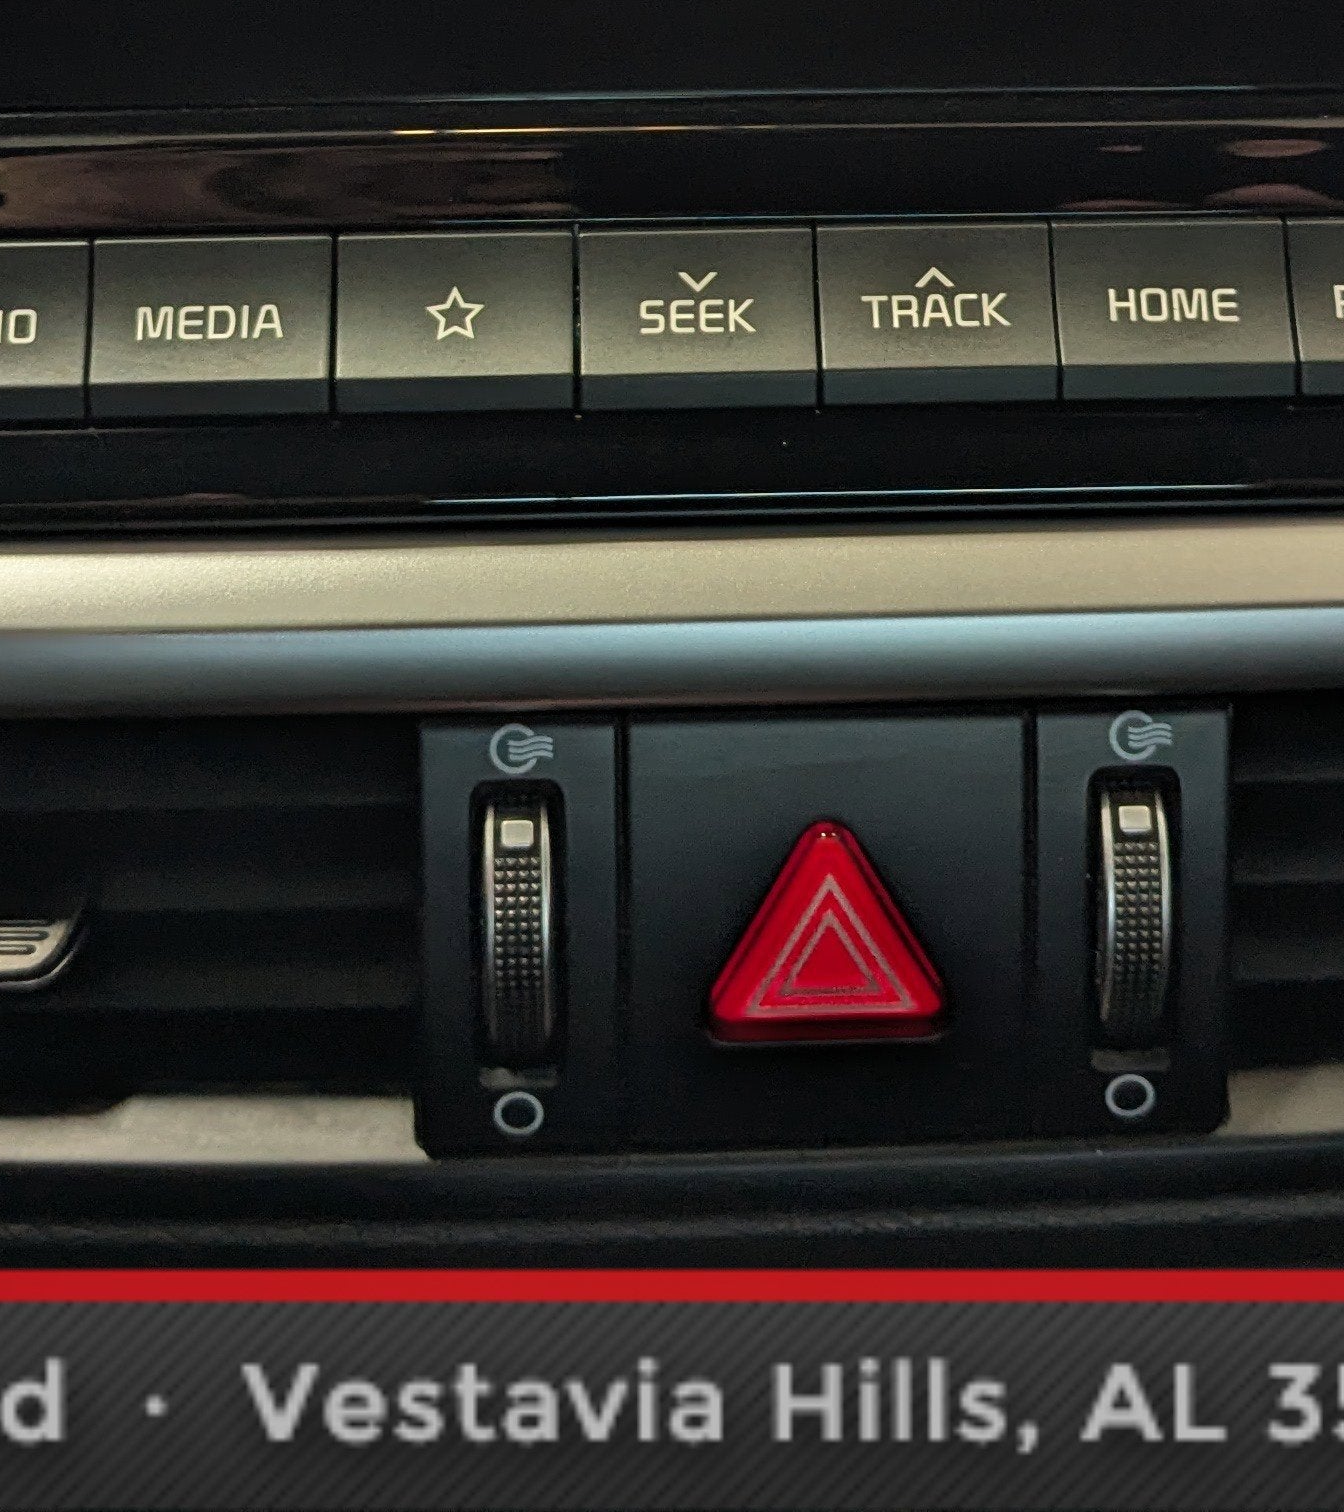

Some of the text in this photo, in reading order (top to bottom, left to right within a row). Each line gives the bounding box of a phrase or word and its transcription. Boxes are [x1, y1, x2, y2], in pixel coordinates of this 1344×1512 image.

[135, 304, 284, 341] MEDIA
[639, 299, 757, 336] SEEK
[861, 292, 1012, 329] TRACK
[1107, 287, 1240, 323] HOME
